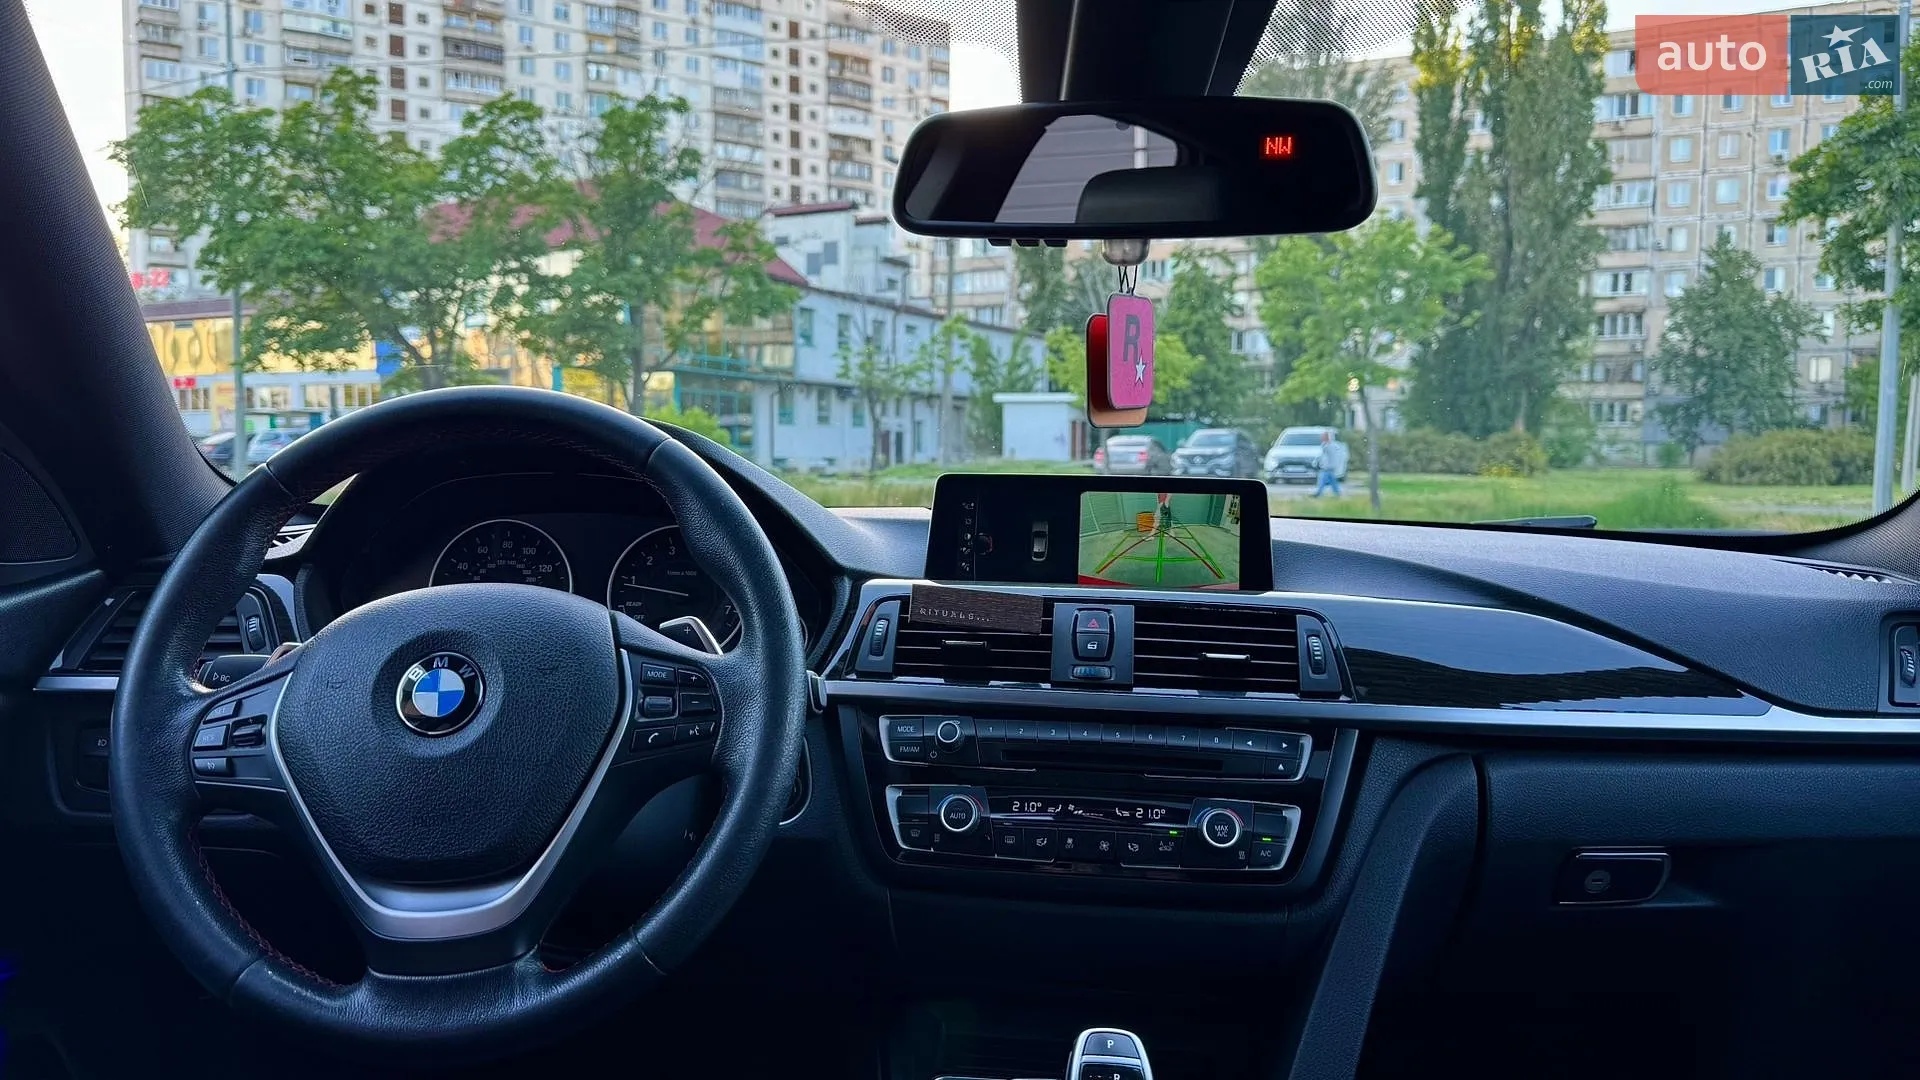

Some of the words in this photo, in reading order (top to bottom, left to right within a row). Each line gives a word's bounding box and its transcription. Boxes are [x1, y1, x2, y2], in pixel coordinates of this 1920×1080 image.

[1265, 137, 1292, 155] NW
[1123, 314, 1141, 362] R
[502, 540, 513, 549] 80
[477, 546, 488, 554] 60
[522, 547, 536, 555] 100
[668, 546, 676, 556] 3
[646, 556, 653, 566] 2
[457, 562, 468, 570] 40
[538, 564, 552, 573] 120
[631, 575, 636, 585] 1
[725, 605, 731, 614] 7
[408, 656, 475, 681] BMW
[220, 674, 230, 682] BC
[646, 670, 667, 678] MODE
[897, 725, 915, 733] MODE
[900, 745, 920, 753] FM/AM
[1260, 849, 1272, 857] A/C
[1107, 1039, 1115, 1049] P
